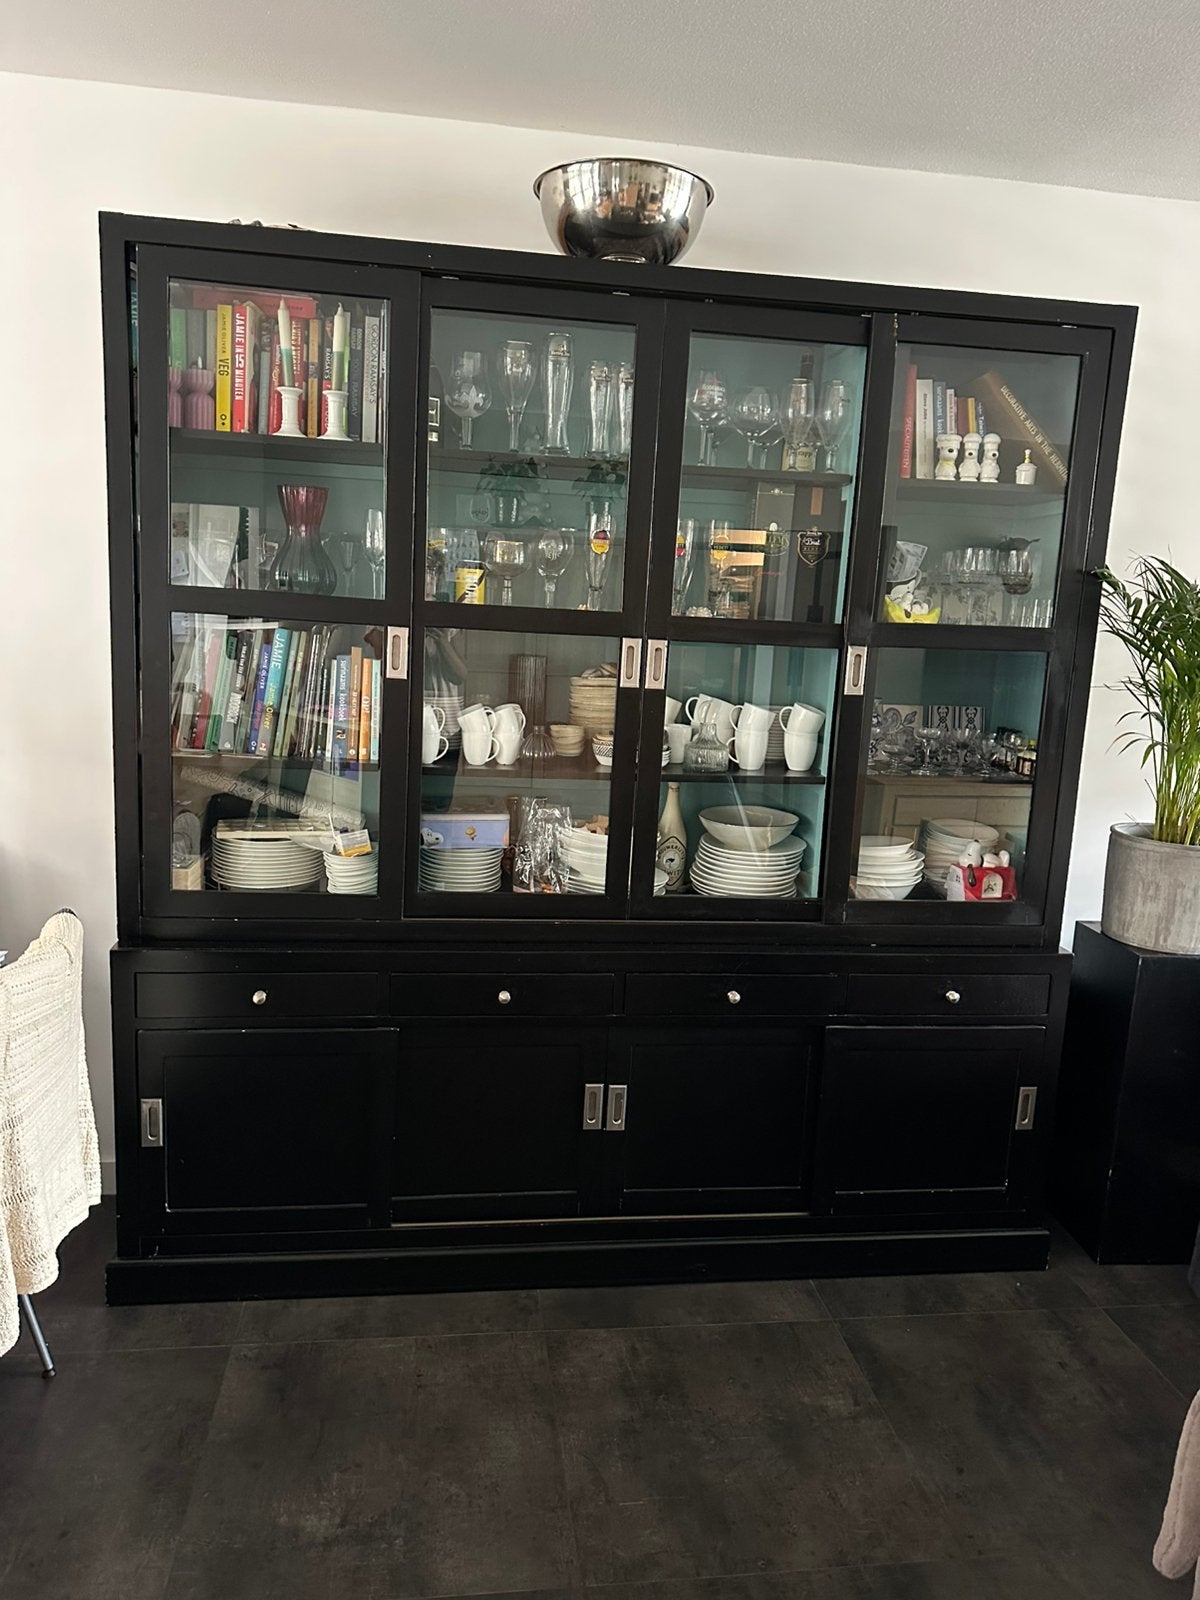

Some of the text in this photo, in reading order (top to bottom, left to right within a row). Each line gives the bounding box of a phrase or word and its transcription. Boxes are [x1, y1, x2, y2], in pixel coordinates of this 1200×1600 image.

[218, 358, 230, 377] VEG
[234, 313, 245, 401] JAMIE IN 15 MINUTEN
[369, 323, 379, 405] GORDON RAMSAY'S
[1000, 385, 1027, 420] DECORATIVE
[1024, 418, 1038, 436] ARTS
[1035, 432, 1044, 444] IN
[1041, 440, 1054, 456] THE
[262, 652, 270, 670] JAMIE
[271, 633, 285, 669] JAMIE
[259, 670, 268, 690] OLIVER
[264, 706, 274, 729] Oliver
[338, 693, 347, 722] kookboek
